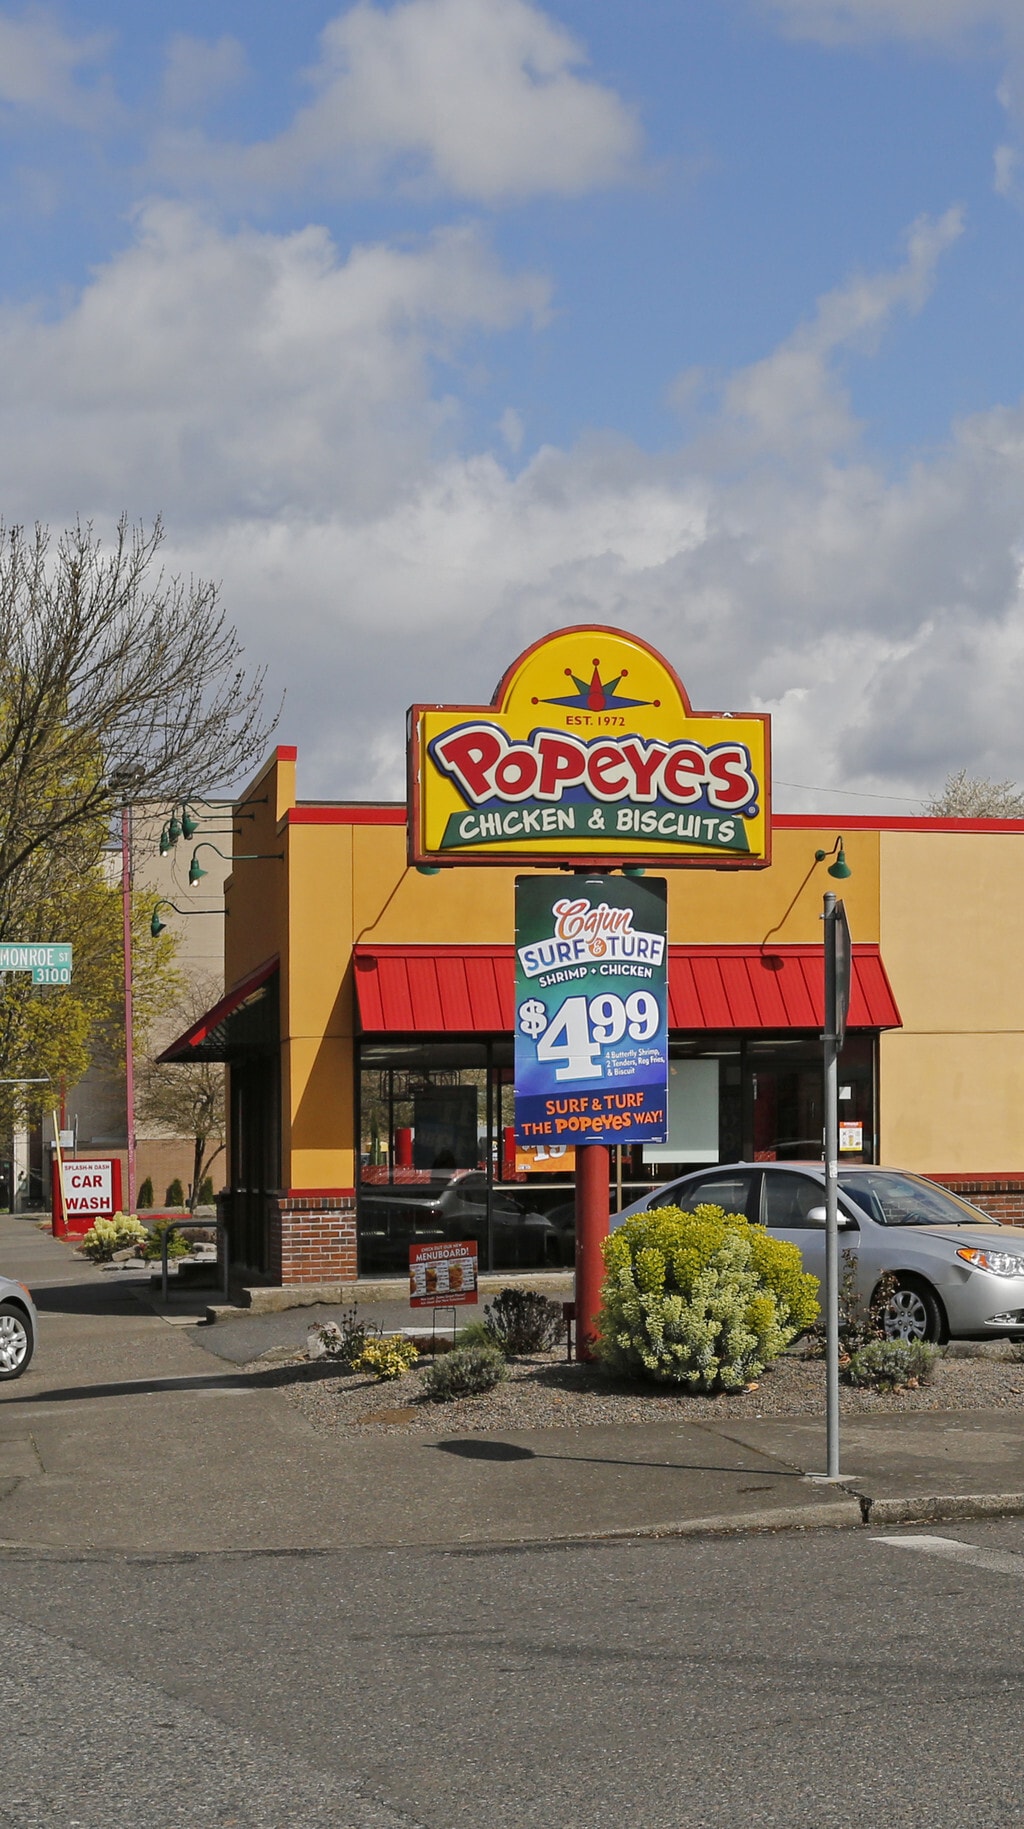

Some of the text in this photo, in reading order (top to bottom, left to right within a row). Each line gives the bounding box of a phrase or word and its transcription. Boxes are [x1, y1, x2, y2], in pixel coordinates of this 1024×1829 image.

[566, 716, 626, 727] EST. 1972
[459, 806, 736, 843] CHICKEN & BISCUITS
[553, 899, 633, 945] Cajun
[0, 948, 69, 967] MONROE ST
[523, 937, 586, 972] SURF
[606, 935, 662, 960] TURF
[37, 968, 69, 982] 3100
[538, 964, 653, 988] SHRIMP CHICKEN
[605, 1048, 660, 1059] 4 Butterfly Shrimp,
[606, 1055, 665, 1068] 2 Tenders, Reg Fries,
[607, 1067, 636, 1077] & Biscuit
[545, 1092, 644, 1116] SURF & TURF
[521, 1121, 552, 1136] THE
[633, 1110, 663, 1125] WAY!
[71, 1175, 103, 1188] CAR
[65, 1197, 110, 1210] WASH
[416, 1247, 469, 1262] MENUBOARD!
